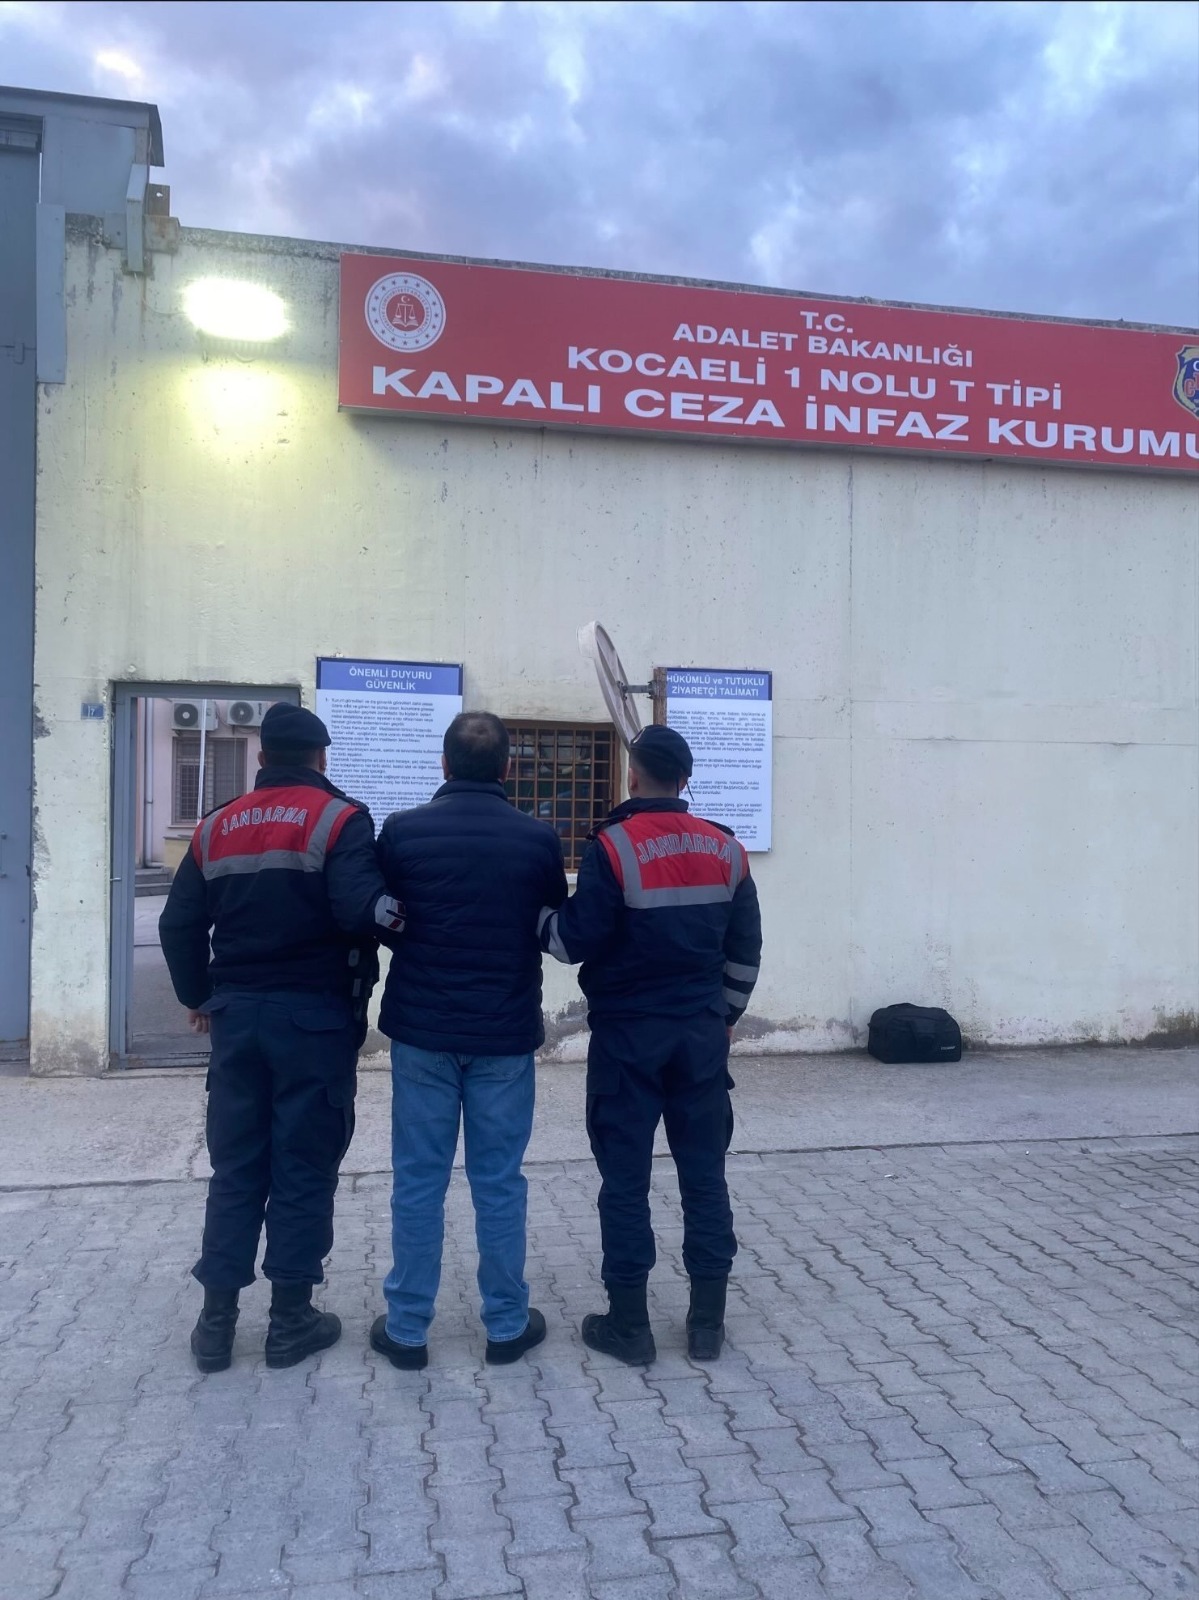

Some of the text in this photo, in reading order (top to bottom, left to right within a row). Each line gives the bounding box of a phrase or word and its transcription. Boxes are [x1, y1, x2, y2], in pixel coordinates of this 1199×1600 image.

[800, 311, 854, 334] T.C.
[672, 323, 973, 368] ADALET BAKANLIĞI
[568, 345, 1062, 411] KOCAELİ 1 NOLU T TİPİ
[372, 365, 601, 413] KAPALI
[624, 388, 786, 428] CEZA
[805, 395, 970, 442] İNFAZ
[349, 665, 432, 680] ÖNEMLİ DUYURU
[666, 673, 711, 685] HÜKÜMLÜ
[724, 676, 765, 686] TUTUKLU
[365, 679, 416, 691] GÜVENLİK
[671, 685, 759, 697] ZİYARETÇİ TALİMATI
[221, 805, 308, 836] JANDARMA
